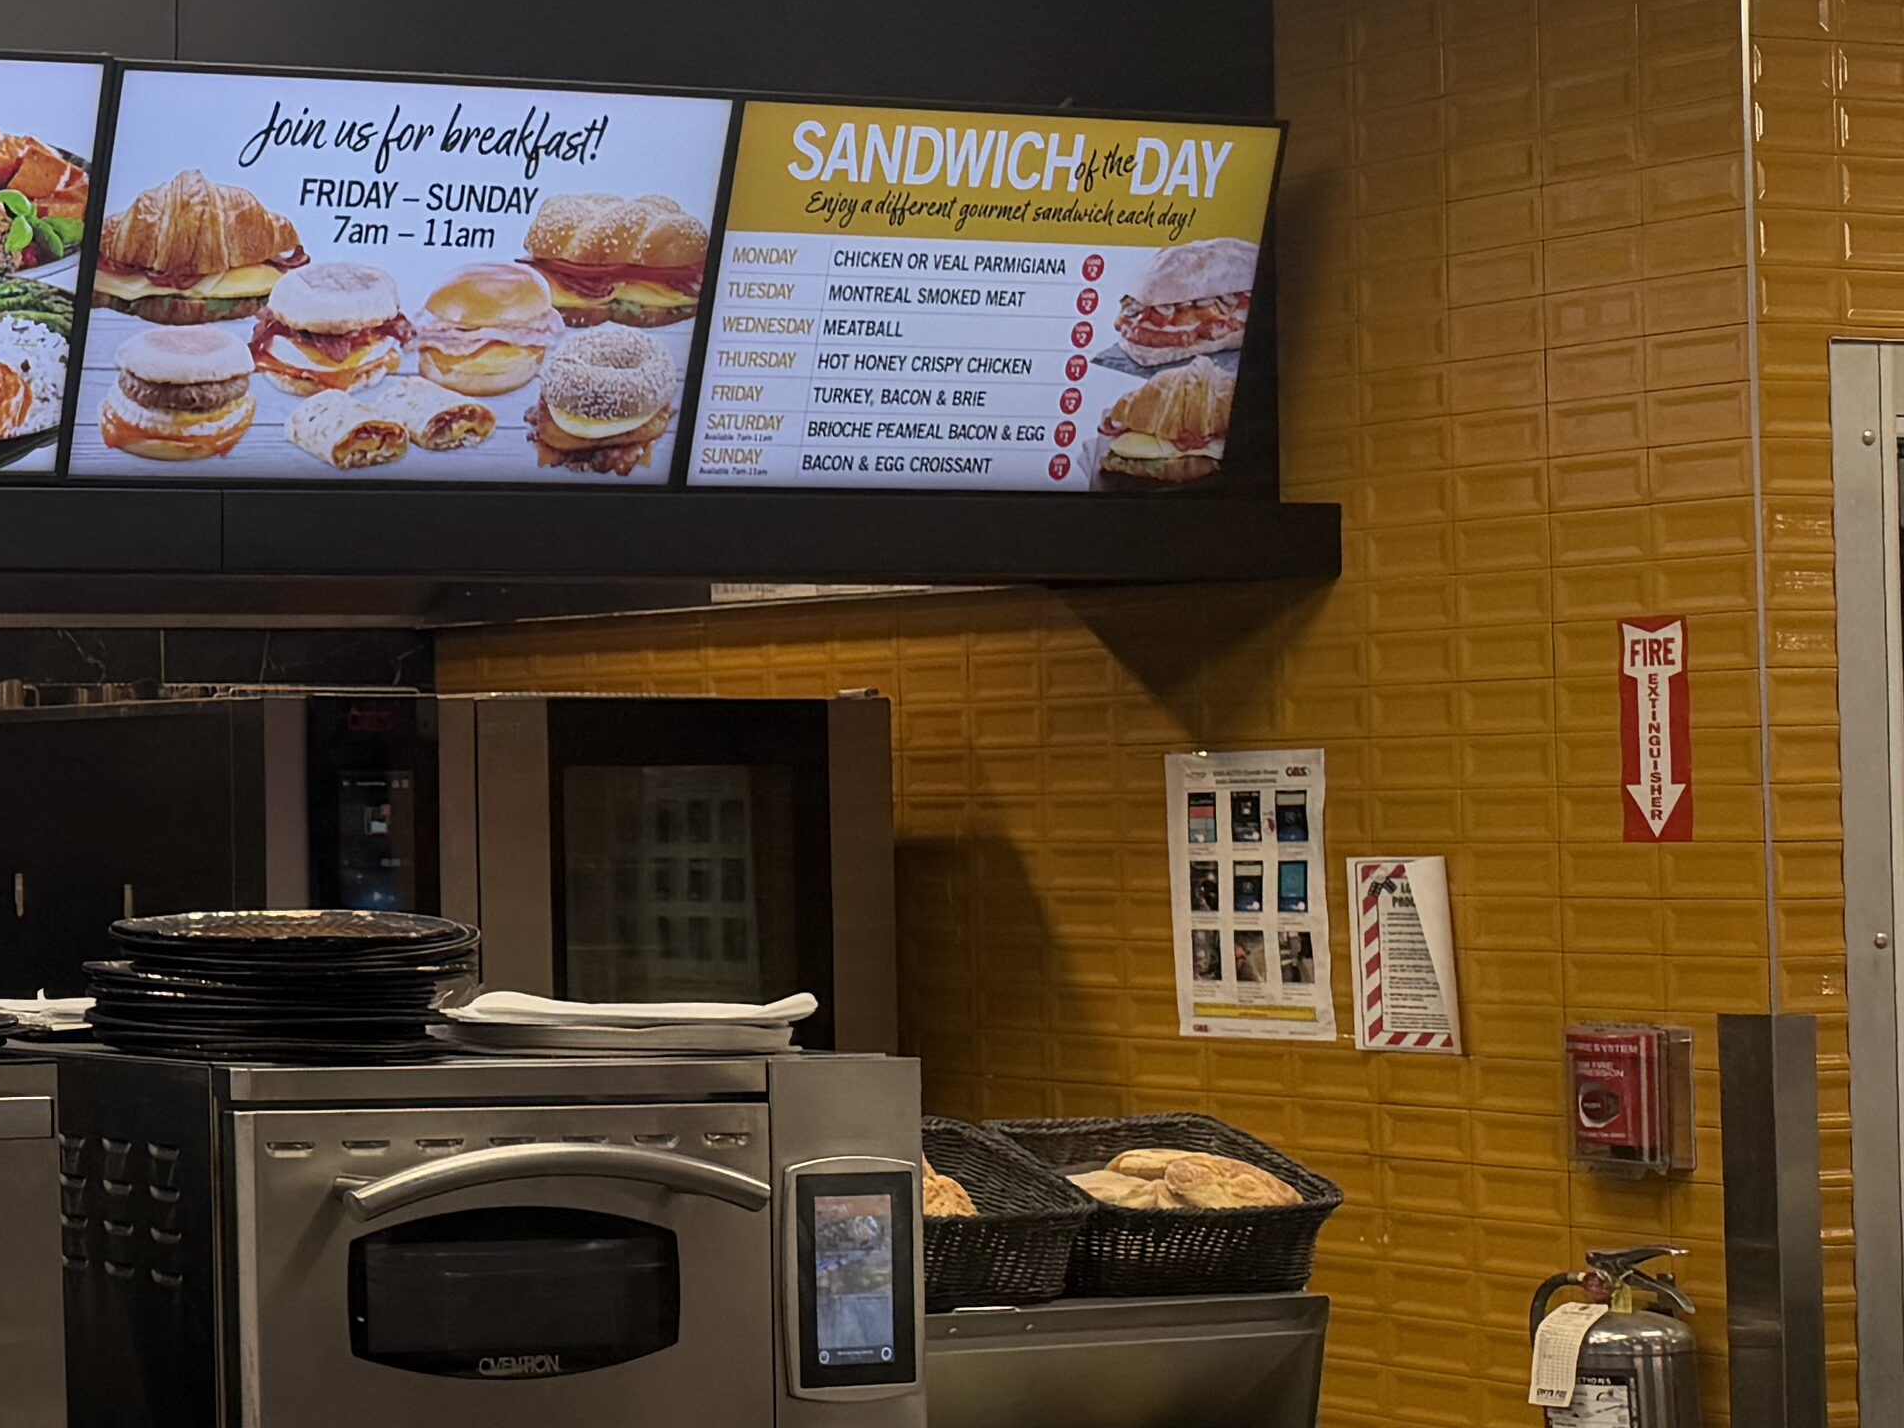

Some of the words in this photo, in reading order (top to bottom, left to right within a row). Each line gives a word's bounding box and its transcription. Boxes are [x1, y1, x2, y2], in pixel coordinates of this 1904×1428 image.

[239, 101, 327, 167] Join
[335, 121, 378, 152] us
[375, 105, 434, 174] for
[440, 103, 608, 180] breakfast!
[788, 121, 1085, 192] SANDWICH
[1075, 151, 1100, 193] of
[1102, 143, 1137, 179] the
[1127, 137, 1233, 197] DAY
[300, 179, 398, 209] FRIDAY
[426, 183, 538, 214] SUNDAY
[805, 191, 858, 228] Enjoy
[861, 199, 872, 213] a
[875, 190, 957, 226] different
[955, 200, 1031, 231] gourmet
[1032, 198, 1114, 226] sandwich
[1117, 201, 1154, 224] each
[1157, 202, 1196, 241] day!
[334, 216, 388, 244] 7am
[424, 219, 494, 248] 11am
[733, 247, 797, 264] MONDAY
[834, 250, 903, 268] CHICKEN
[908, 253, 928, 269] OR
[934, 255, 969, 271] VEAL
[974, 256, 1065, 274] PARMIGIANA
[728, 282, 795, 299] TUESDAY
[829, 285, 911, 303] MONTREAL
[918, 288, 980, 305] SMOKED
[986, 291, 1025, 307] MEAT
[723, 316, 814, 334] WEDNESDAY
[823, 319, 902, 337] MEATBALL
[718, 351, 796, 368] THURSDAY
[818, 354, 850, 369] HOT
[854, 354, 907, 371] HONEY
[912, 356, 963, 372] CRISPY
[968, 357, 1032, 374] CHICKEN
[711, 385, 763, 402] FRIDAY
[814, 387, 873, 406] TURKEY,
[881, 389, 931, 405] BACON
[936, 390, 946, 405] &
[952, 391, 986, 406] BRIE
[707, 414, 784, 431] SATURDAY
[808, 421, 872, 438] BRIOCHE
[876, 423, 943, 439] PEAMEAL
[948, 424, 997, 440] BACON
[1002, 425, 1011, 440] &
[1016, 426, 1045, 441] EGG
[1630, 637, 1676, 667] FIRE
[1647, 673, 1663, 821] EXTINGUISHER
